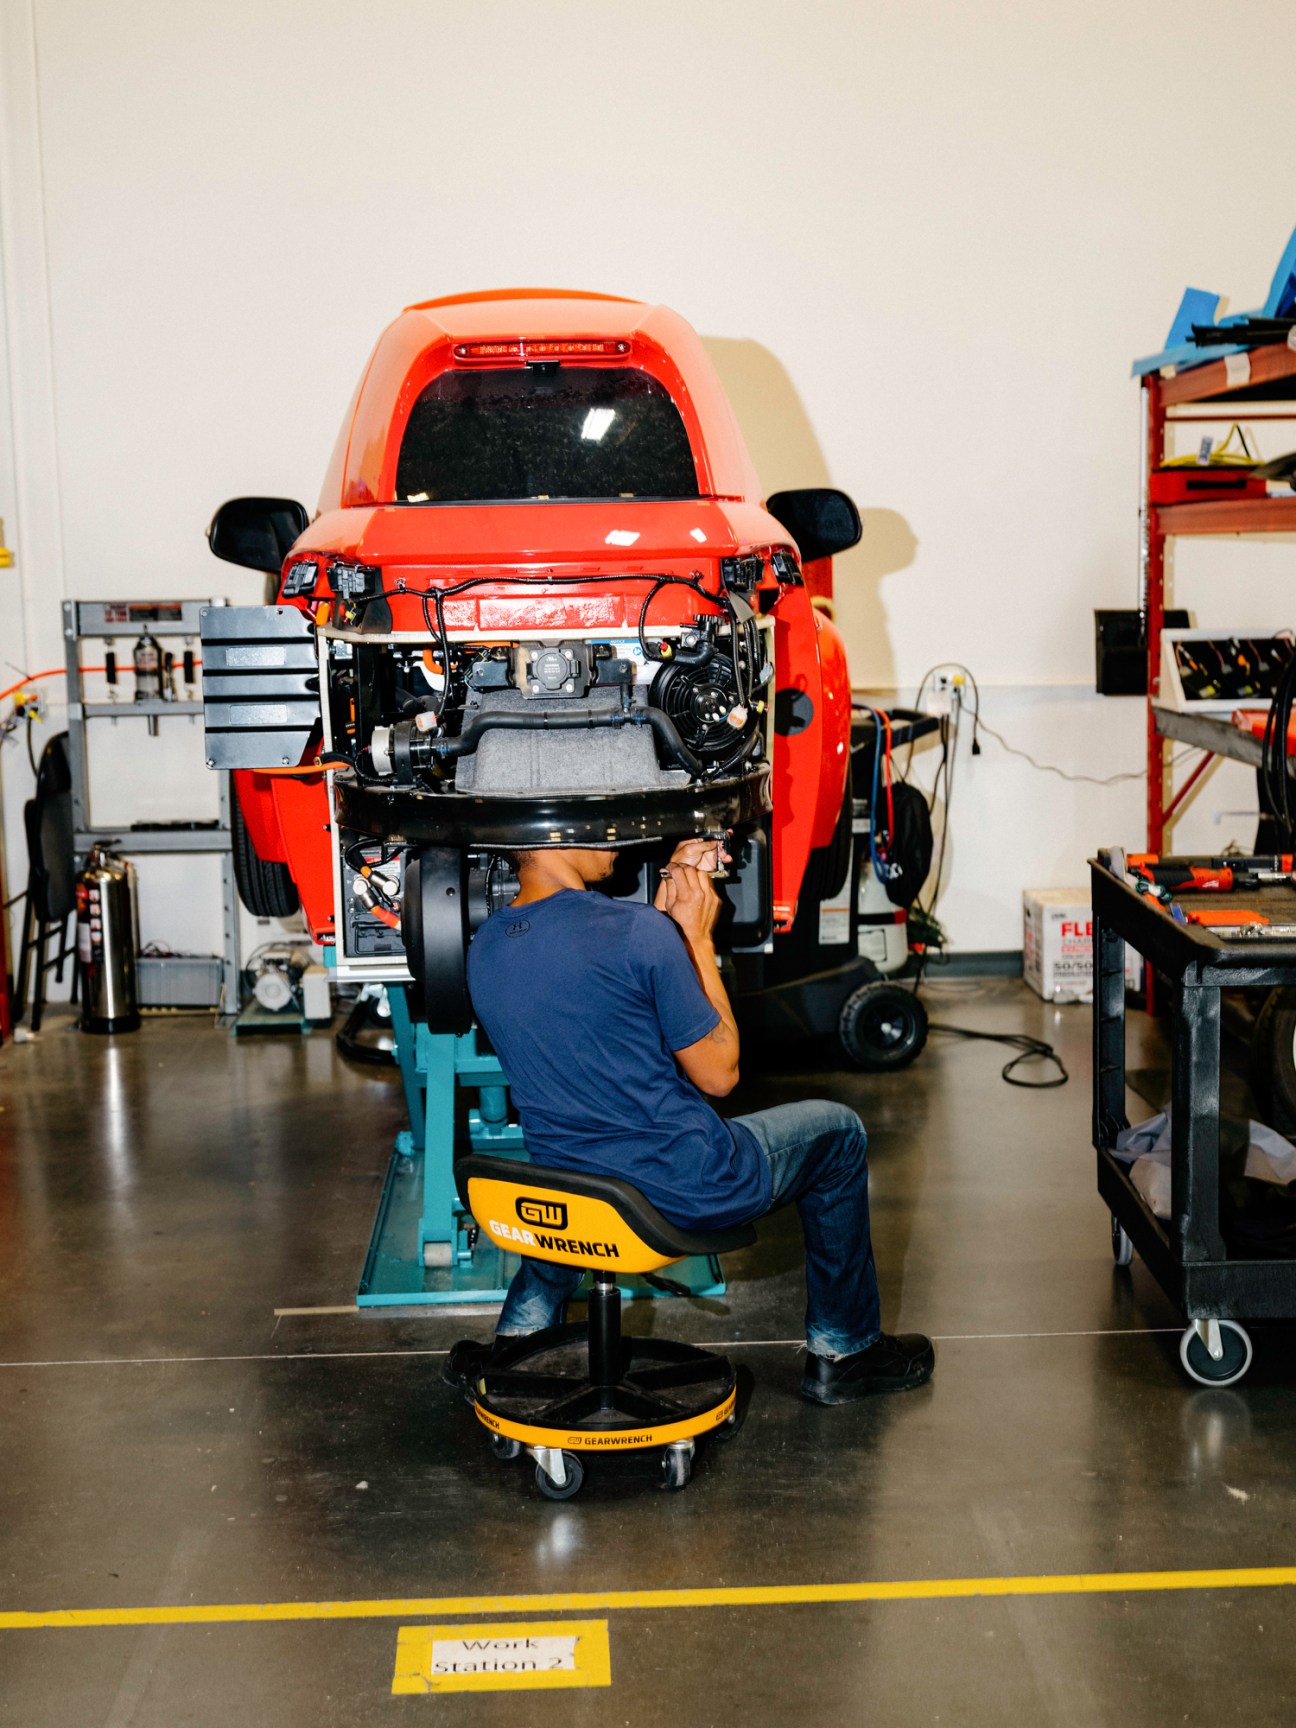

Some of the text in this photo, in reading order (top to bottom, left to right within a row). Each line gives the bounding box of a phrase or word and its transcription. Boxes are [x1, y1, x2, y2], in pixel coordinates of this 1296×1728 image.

[584, 1434, 653, 1445] GEARWRENCH
[462, 1638, 539, 1650] Work
[434, 1657, 563, 1673] Station 2
